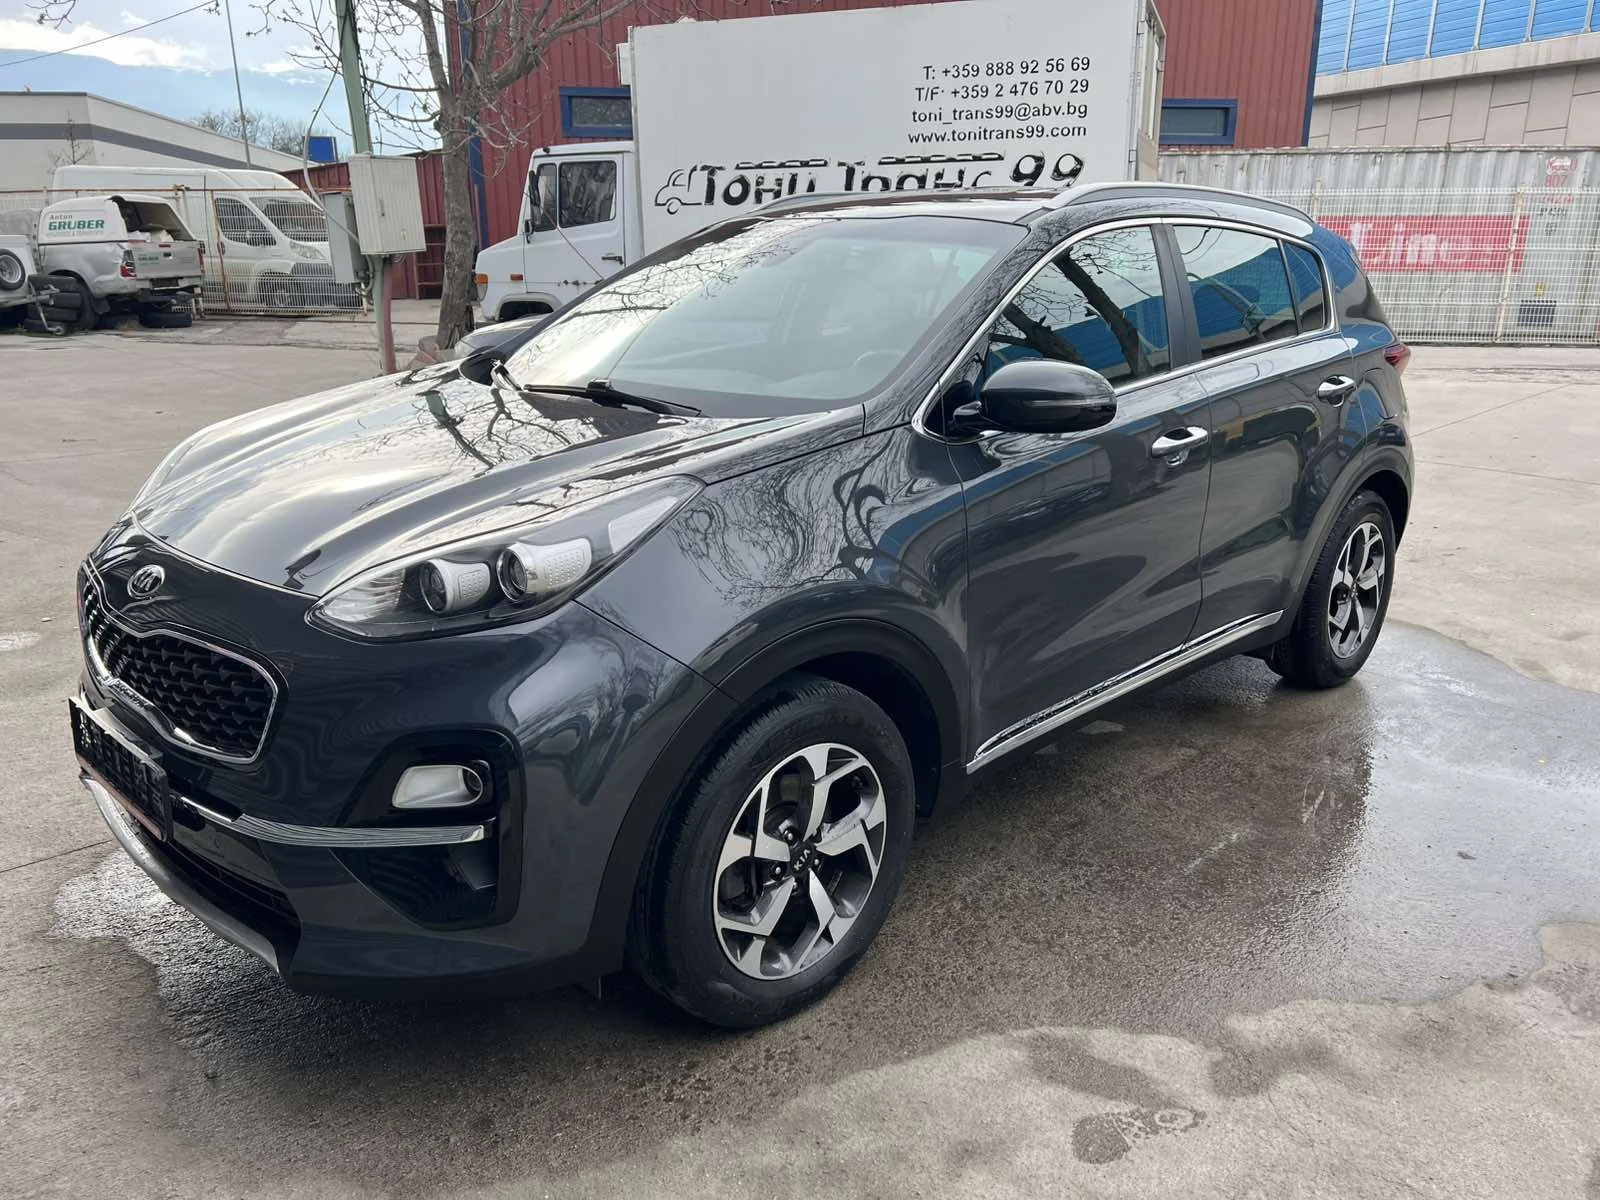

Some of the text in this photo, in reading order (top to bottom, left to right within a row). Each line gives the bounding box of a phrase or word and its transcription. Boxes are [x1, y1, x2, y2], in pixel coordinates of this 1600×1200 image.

[923, 56, 1090, 80] T: +359 888 92 56 69
[951, 84, 989, 99] +359
[995, 83, 1004, 97] 2
[1009, 81, 1039, 96] 476
[1044, 80, 1064, 95] 70
[1070, 79, 1089, 94] 29
[912, 102, 1088, 125] toni_trans99@abv.bg
[908, 124, 1087, 144] www.tonitrans99.com
[48, 219, 105, 231] GRUBER
[794, 849, 811, 871] KIA
